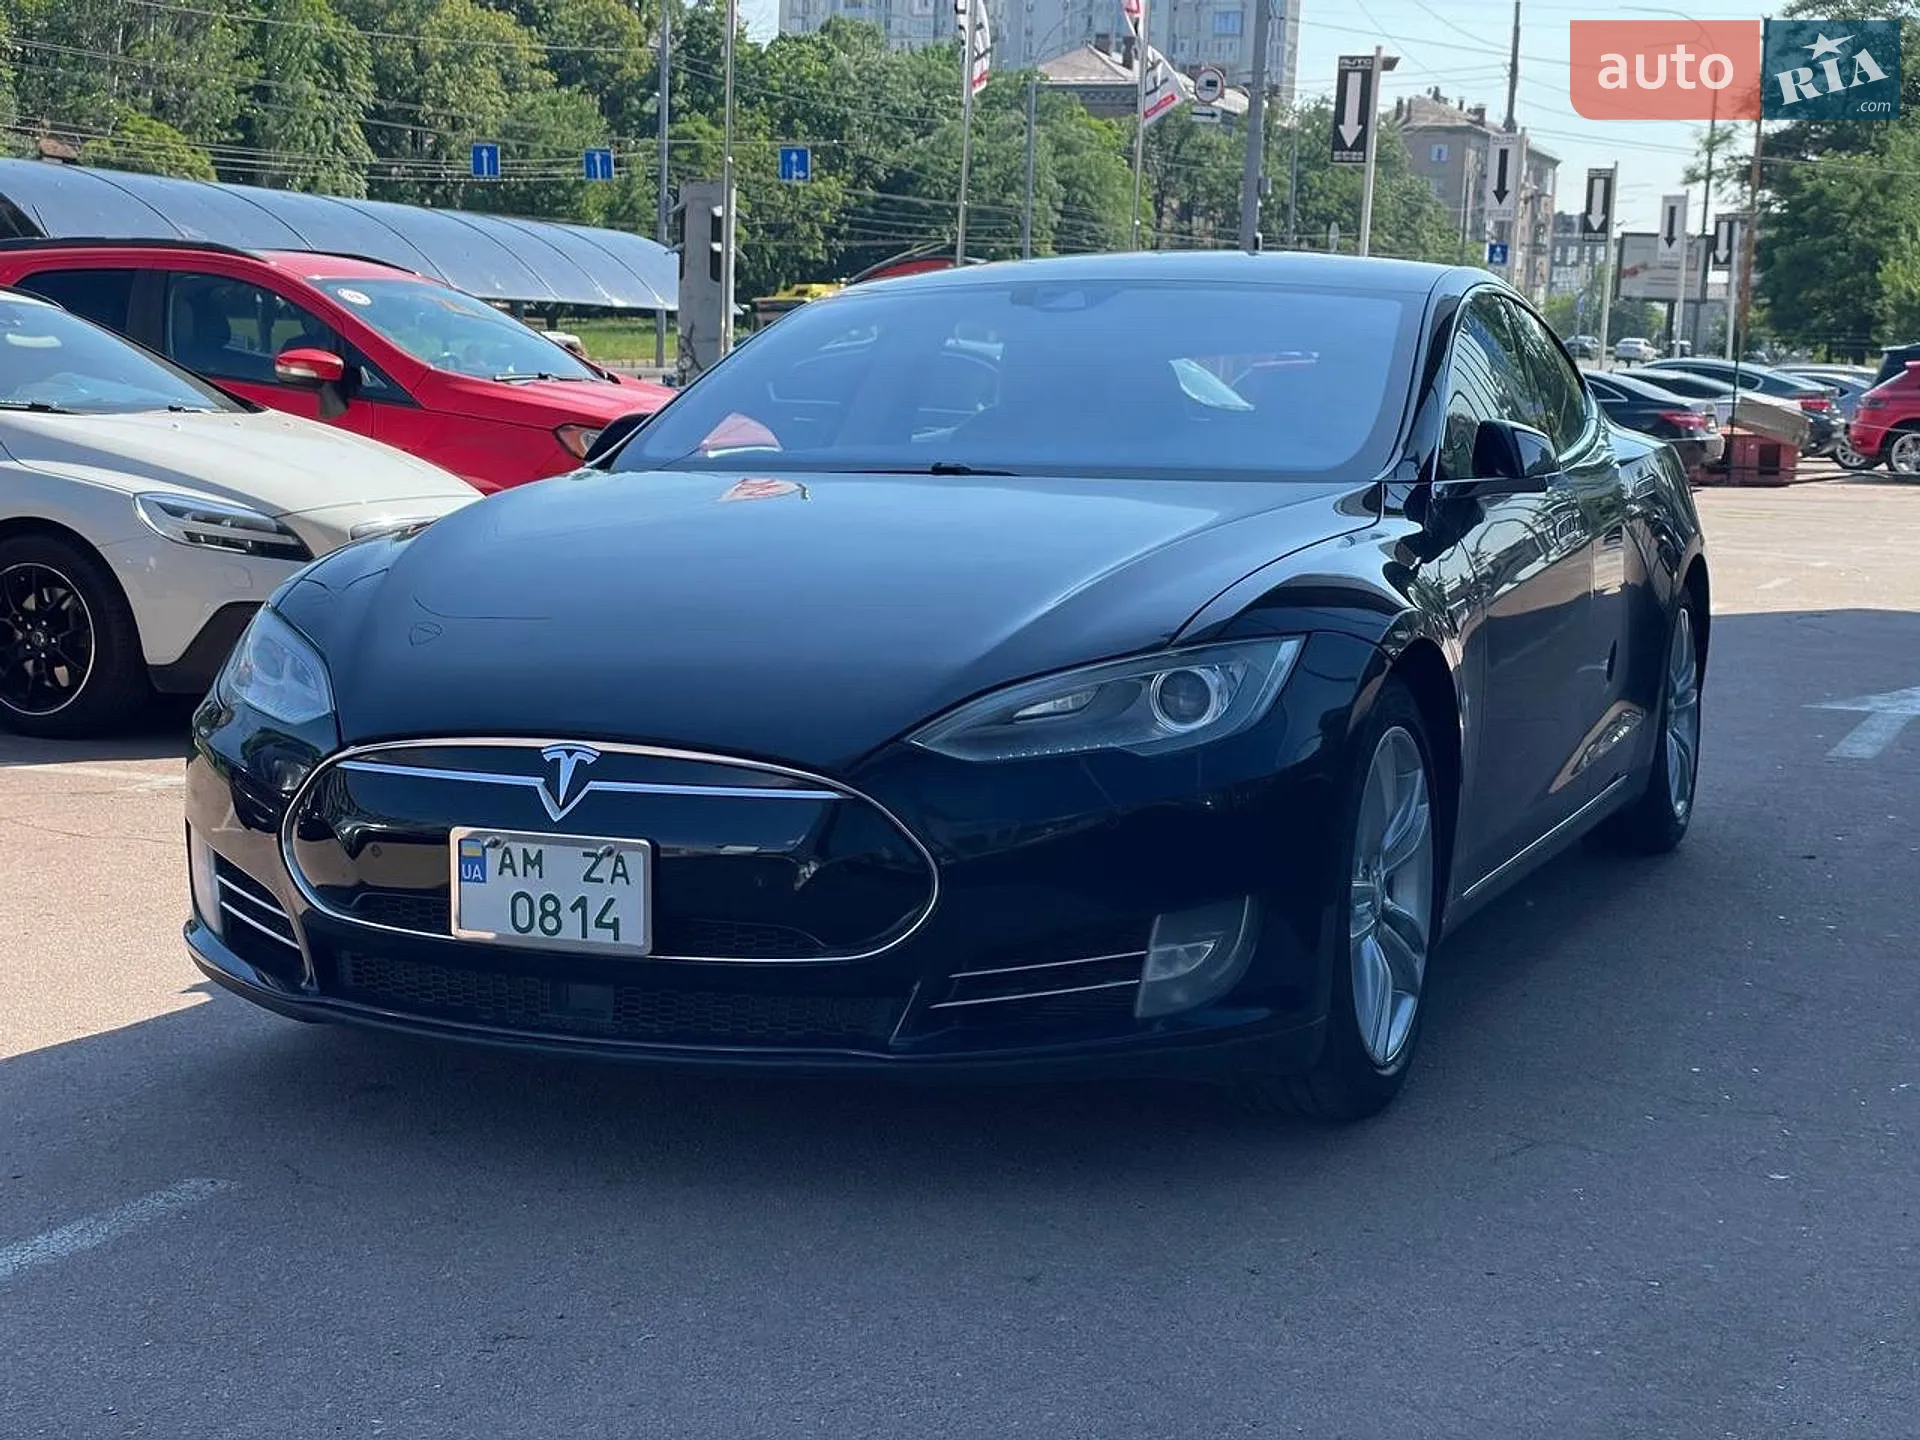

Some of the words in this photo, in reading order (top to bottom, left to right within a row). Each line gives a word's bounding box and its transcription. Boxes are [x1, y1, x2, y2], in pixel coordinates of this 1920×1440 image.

[461, 866, 482, 881] UA
[498, 846, 543, 879] AM
[582, 850, 630, 886] ZA
[510, 890, 620, 942] 0814
